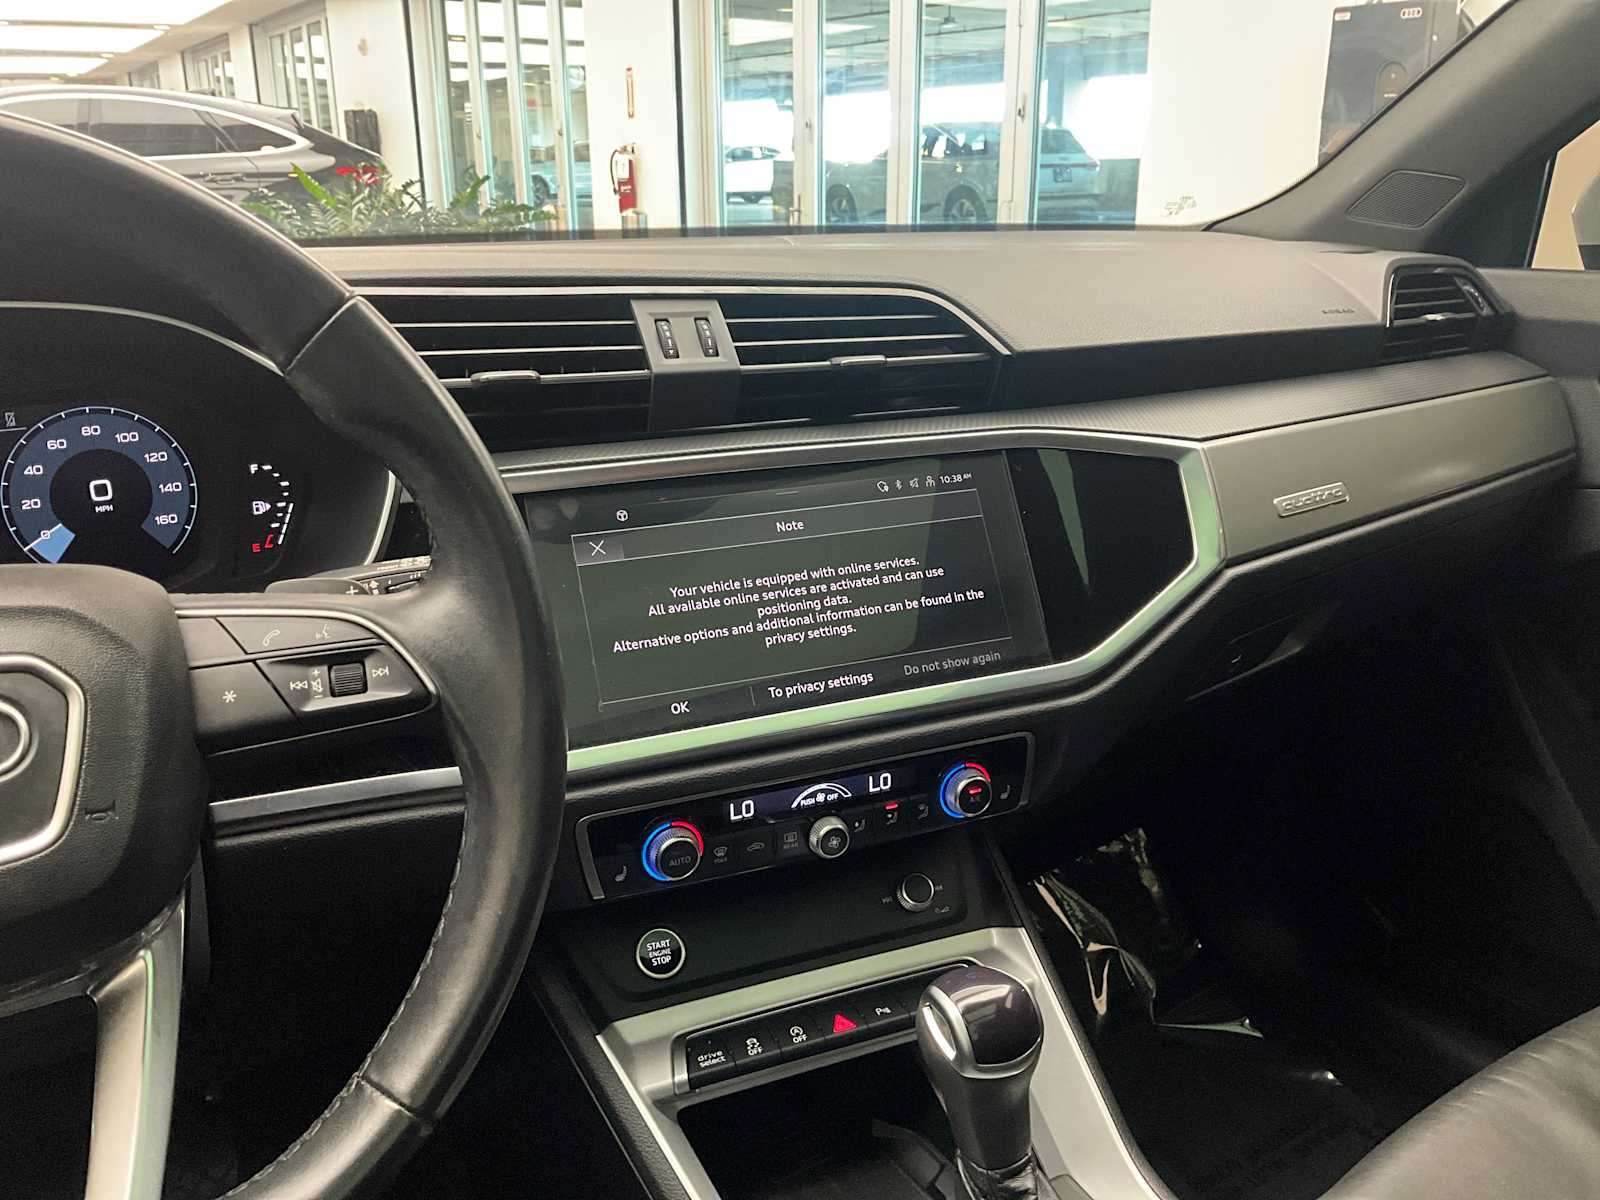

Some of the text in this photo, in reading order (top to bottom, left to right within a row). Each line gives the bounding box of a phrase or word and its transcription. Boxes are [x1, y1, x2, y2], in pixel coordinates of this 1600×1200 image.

[81, 425, 101, 436] 80
[114, 431, 139, 443] 100
[47, 439, 67, 450] 60
[144, 451, 168, 463] 120
[23, 464, 43, 476] 40
[250, 464, 258, 474] F
[939, 474, 962, 485] 10:38
[89, 479, 113, 502] 0
[158, 482, 182, 493] 140
[21, 499, 41, 510] 20
[95, 504, 114, 513] MPH
[154, 514, 178, 525] 160
[776, 519, 804, 533] Note
[251, 543, 261, 552] E
[669, 556, 920, 598] Your vehicle is equipped with online services.
[648, 567, 945, 617] All available online services are activated and can use
[757, 594, 853, 619] positioning data.
[613, 588, 985, 653] Alternative options and additional information can be found in the
[765, 622, 857, 648] privacy settings.
[904, 651, 1001, 676] Do not show again
[768, 672, 874, 698] To privacy settings
[670, 701, 690, 714] OK
[868, 772, 892, 793] LO
[800, 792, 839, 807] PUSH OFF
[729, 800, 755, 822] LO
[669, 855, 692, 867] AUTO
[646, 939, 671, 950] START
[649, 948, 672, 958] ENGINE
[651, 955, 672, 966] STOP
[792, 1034, 807, 1043] OFF
[697, 1050, 723, 1062] drive
[748, 1046, 763, 1056] OFF
[699, 1055, 727, 1068] select
